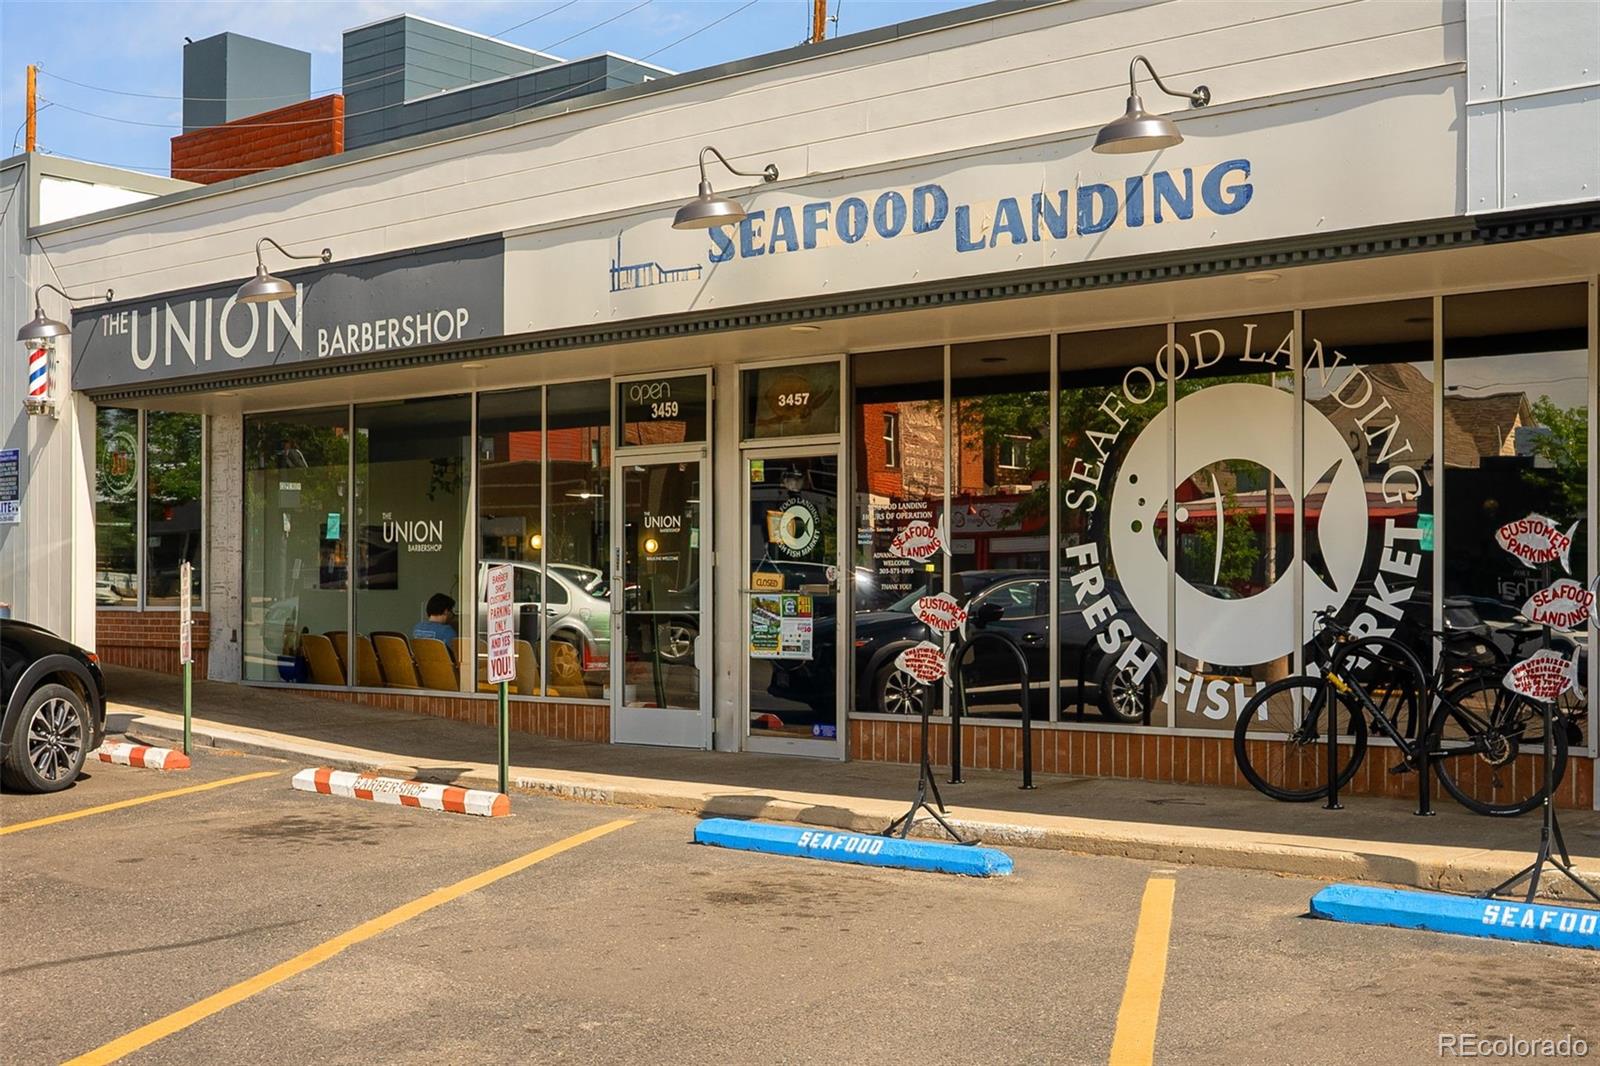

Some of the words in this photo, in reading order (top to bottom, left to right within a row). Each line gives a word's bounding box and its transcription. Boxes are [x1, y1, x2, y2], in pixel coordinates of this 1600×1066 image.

[708, 183, 950, 265] SEAFOOD
[955, 159, 1254, 253] LANDING
[101, 311, 129, 337] THE
[131, 283, 303, 370] UNION
[317, 307, 470, 358] BARBERSHOP
[630, 381, 671, 405] open
[778, 392, 810, 407] 3457
[651, 401, 679, 419] 3459
[1065, 328, 1226, 513] SEAFOOD
[1239, 323, 1422, 504] LANDING
[862, 512, 885, 520] HRS
[886, 512, 895, 520] OF
[896, 511, 933, 520] OPERATION
[868, 502, 897, 512] FOOD
[898, 502, 927, 510] LANDING
[383, 520, 443, 543] UNION
[644, 515, 681, 528] UNION
[892, 526, 935, 549] SEAFOOD
[1500, 520, 1569, 551] CUSTOMER
[408, 544, 442, 552] BARBERSHOP
[900, 537, 941, 557] LANDING
[1507, 538, 1559, 562] PARKING
[756, 578, 779, 587] CLOSED
[1533, 585, 1594, 607] SEAFOOD
[490, 604, 511, 619] PARKING
[919, 598, 967, 623] CUSTOMER
[920, 611, 957, 630] PARKING
[1533, 606, 1589, 627] LANDING
[1065, 543, 1157, 685] FRESH
[1161, 666, 1269, 721] FISH
[491, 656, 511, 677] YOU!
[352, 776, 428, 796] BARBERSHOP
[798, 831, 884, 856] SEAFOOD
[1482, 904, 1600, 935] SEAFOO
